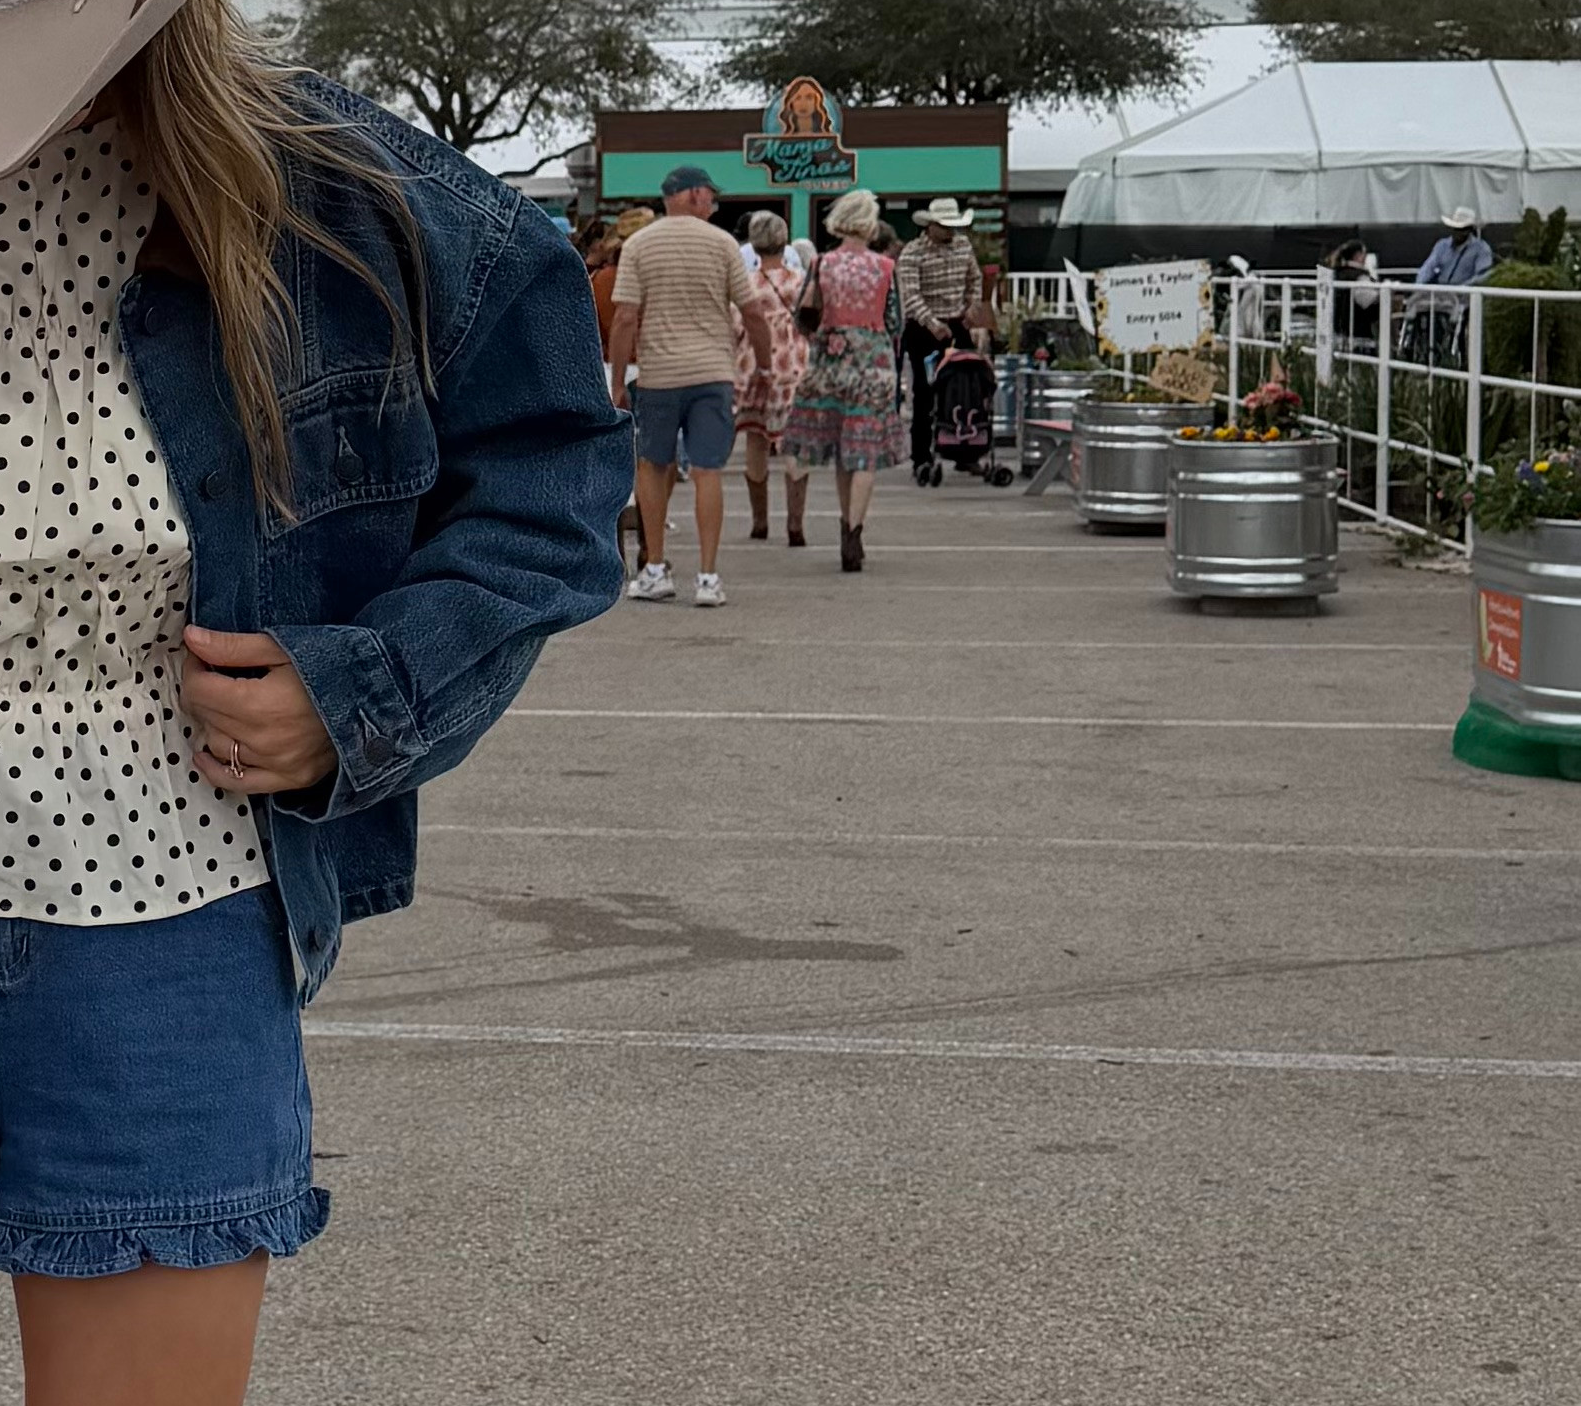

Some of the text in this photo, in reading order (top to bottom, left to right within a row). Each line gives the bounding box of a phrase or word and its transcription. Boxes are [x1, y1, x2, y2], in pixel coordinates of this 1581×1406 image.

[1110, 277, 1144, 288] James
[1160, 270, 1194, 284] Taylor
[1126, 314, 1156, 325] Entry
